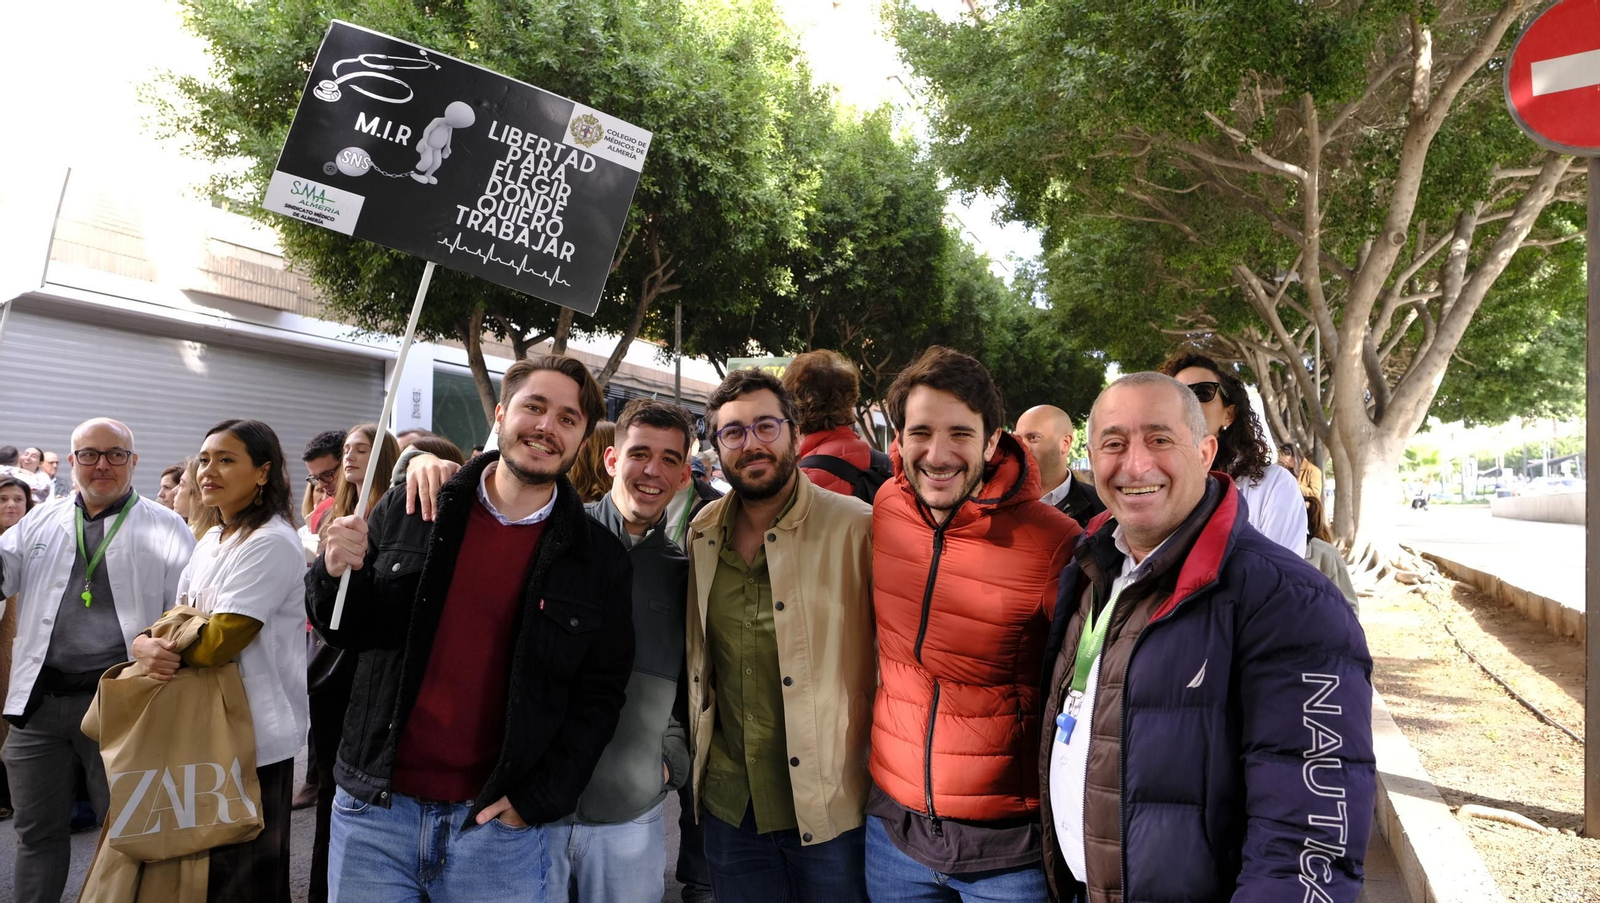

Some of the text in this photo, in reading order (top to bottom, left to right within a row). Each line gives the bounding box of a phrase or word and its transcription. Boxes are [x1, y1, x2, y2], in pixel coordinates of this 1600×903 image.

[354, 111, 412, 146] M.I.R
[487, 120, 597, 173] LIBERTAD
[603, 135, 645, 156] MÉDICOS DE
[606, 128, 647, 148] COLEGIO DE
[341, 150, 371, 170] SNS
[505, 145, 566, 184] PARA
[606, 144, 637, 160] ALMERÍA
[484, 176, 567, 221] DONDE
[491, 159, 572, 205] ELEGIR
[284, 203, 335, 222] SINDICATO MÉDICO
[477, 194, 564, 238] QUIERO
[455, 204, 576, 263] TRABAJAR
[109, 756, 258, 839] ZARA
